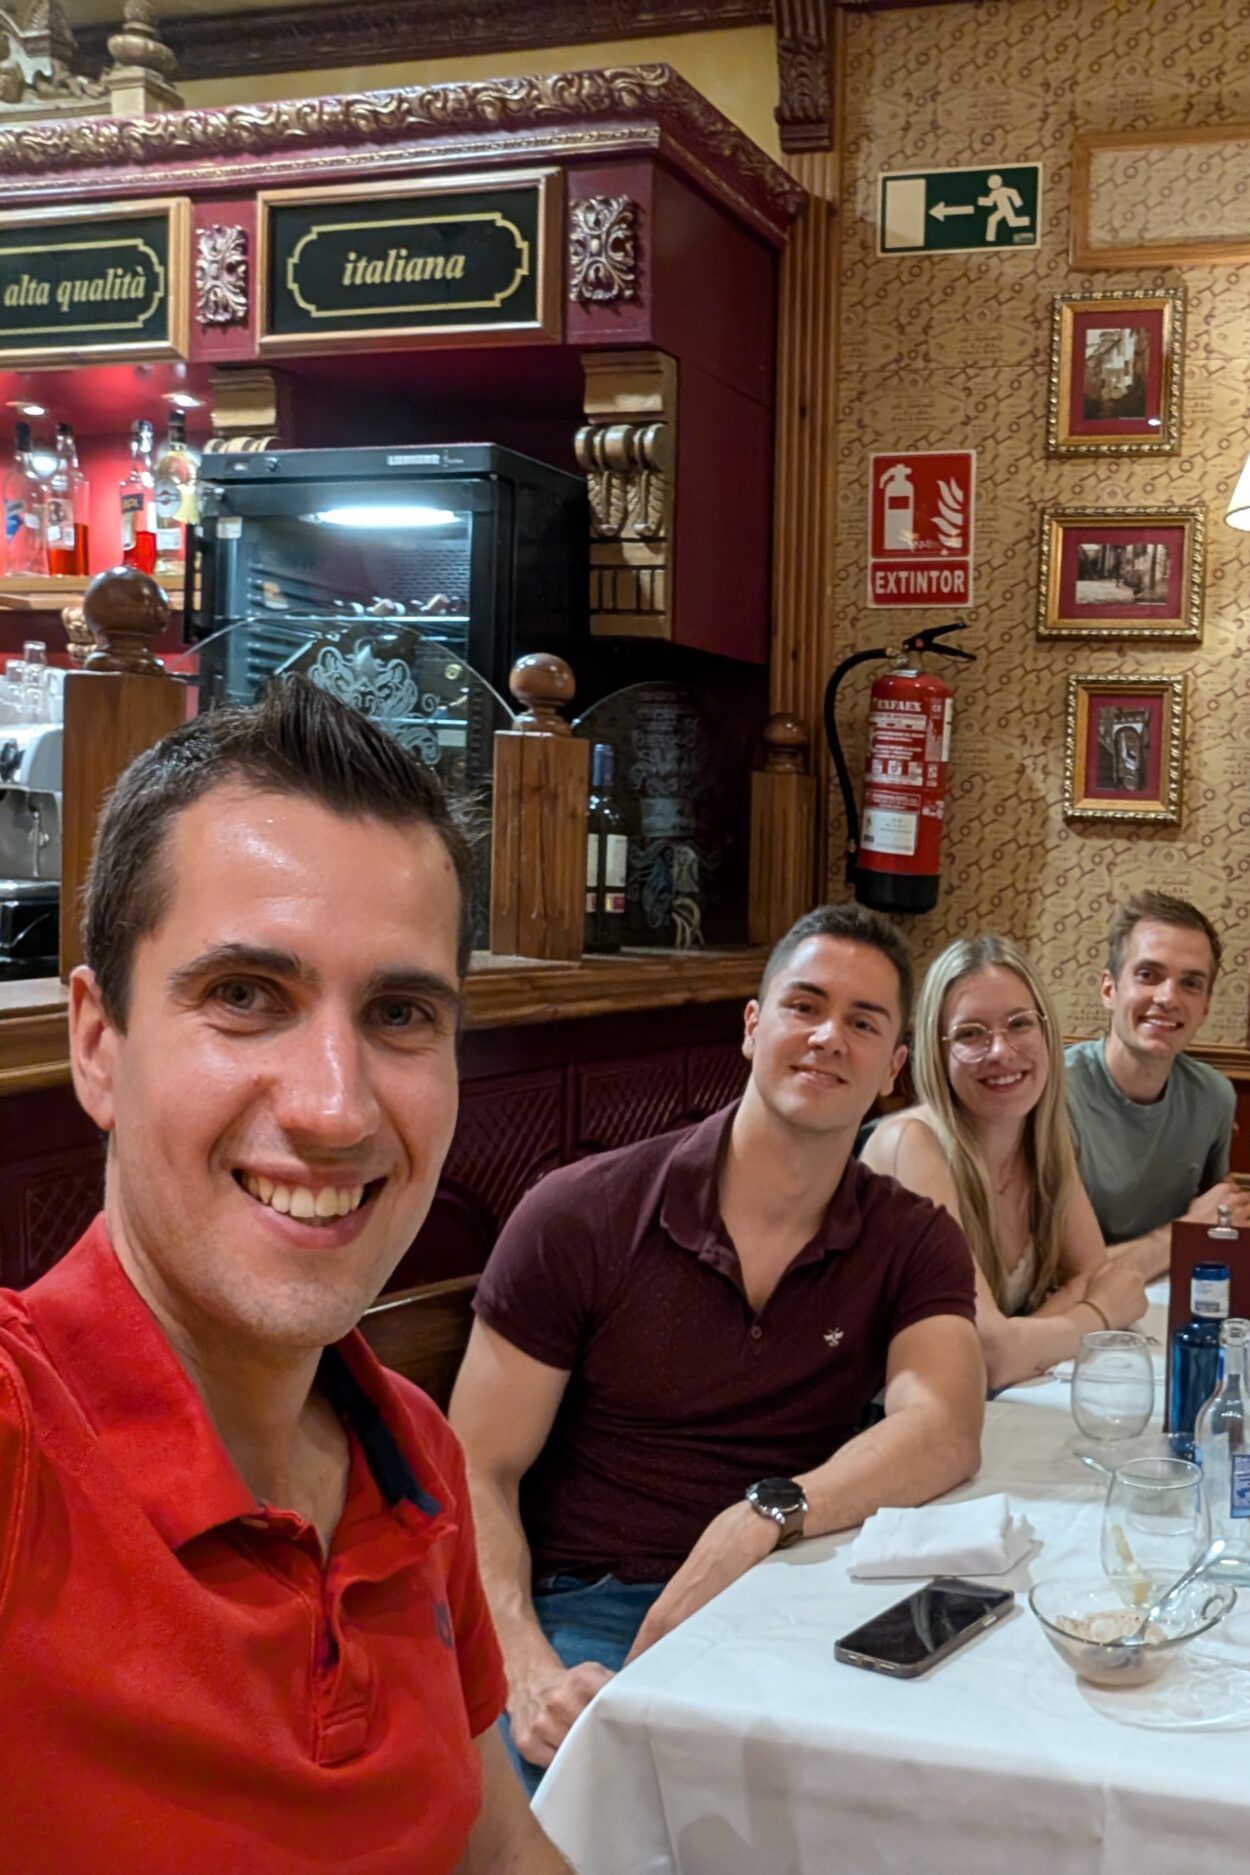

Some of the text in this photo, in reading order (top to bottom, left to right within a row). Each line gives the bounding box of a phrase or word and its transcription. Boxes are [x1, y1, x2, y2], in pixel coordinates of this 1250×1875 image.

[342, 251, 465, 287] italiana
[4, 265, 147, 313] alta qualità
[874, 570, 966, 595] EXTINTOR
